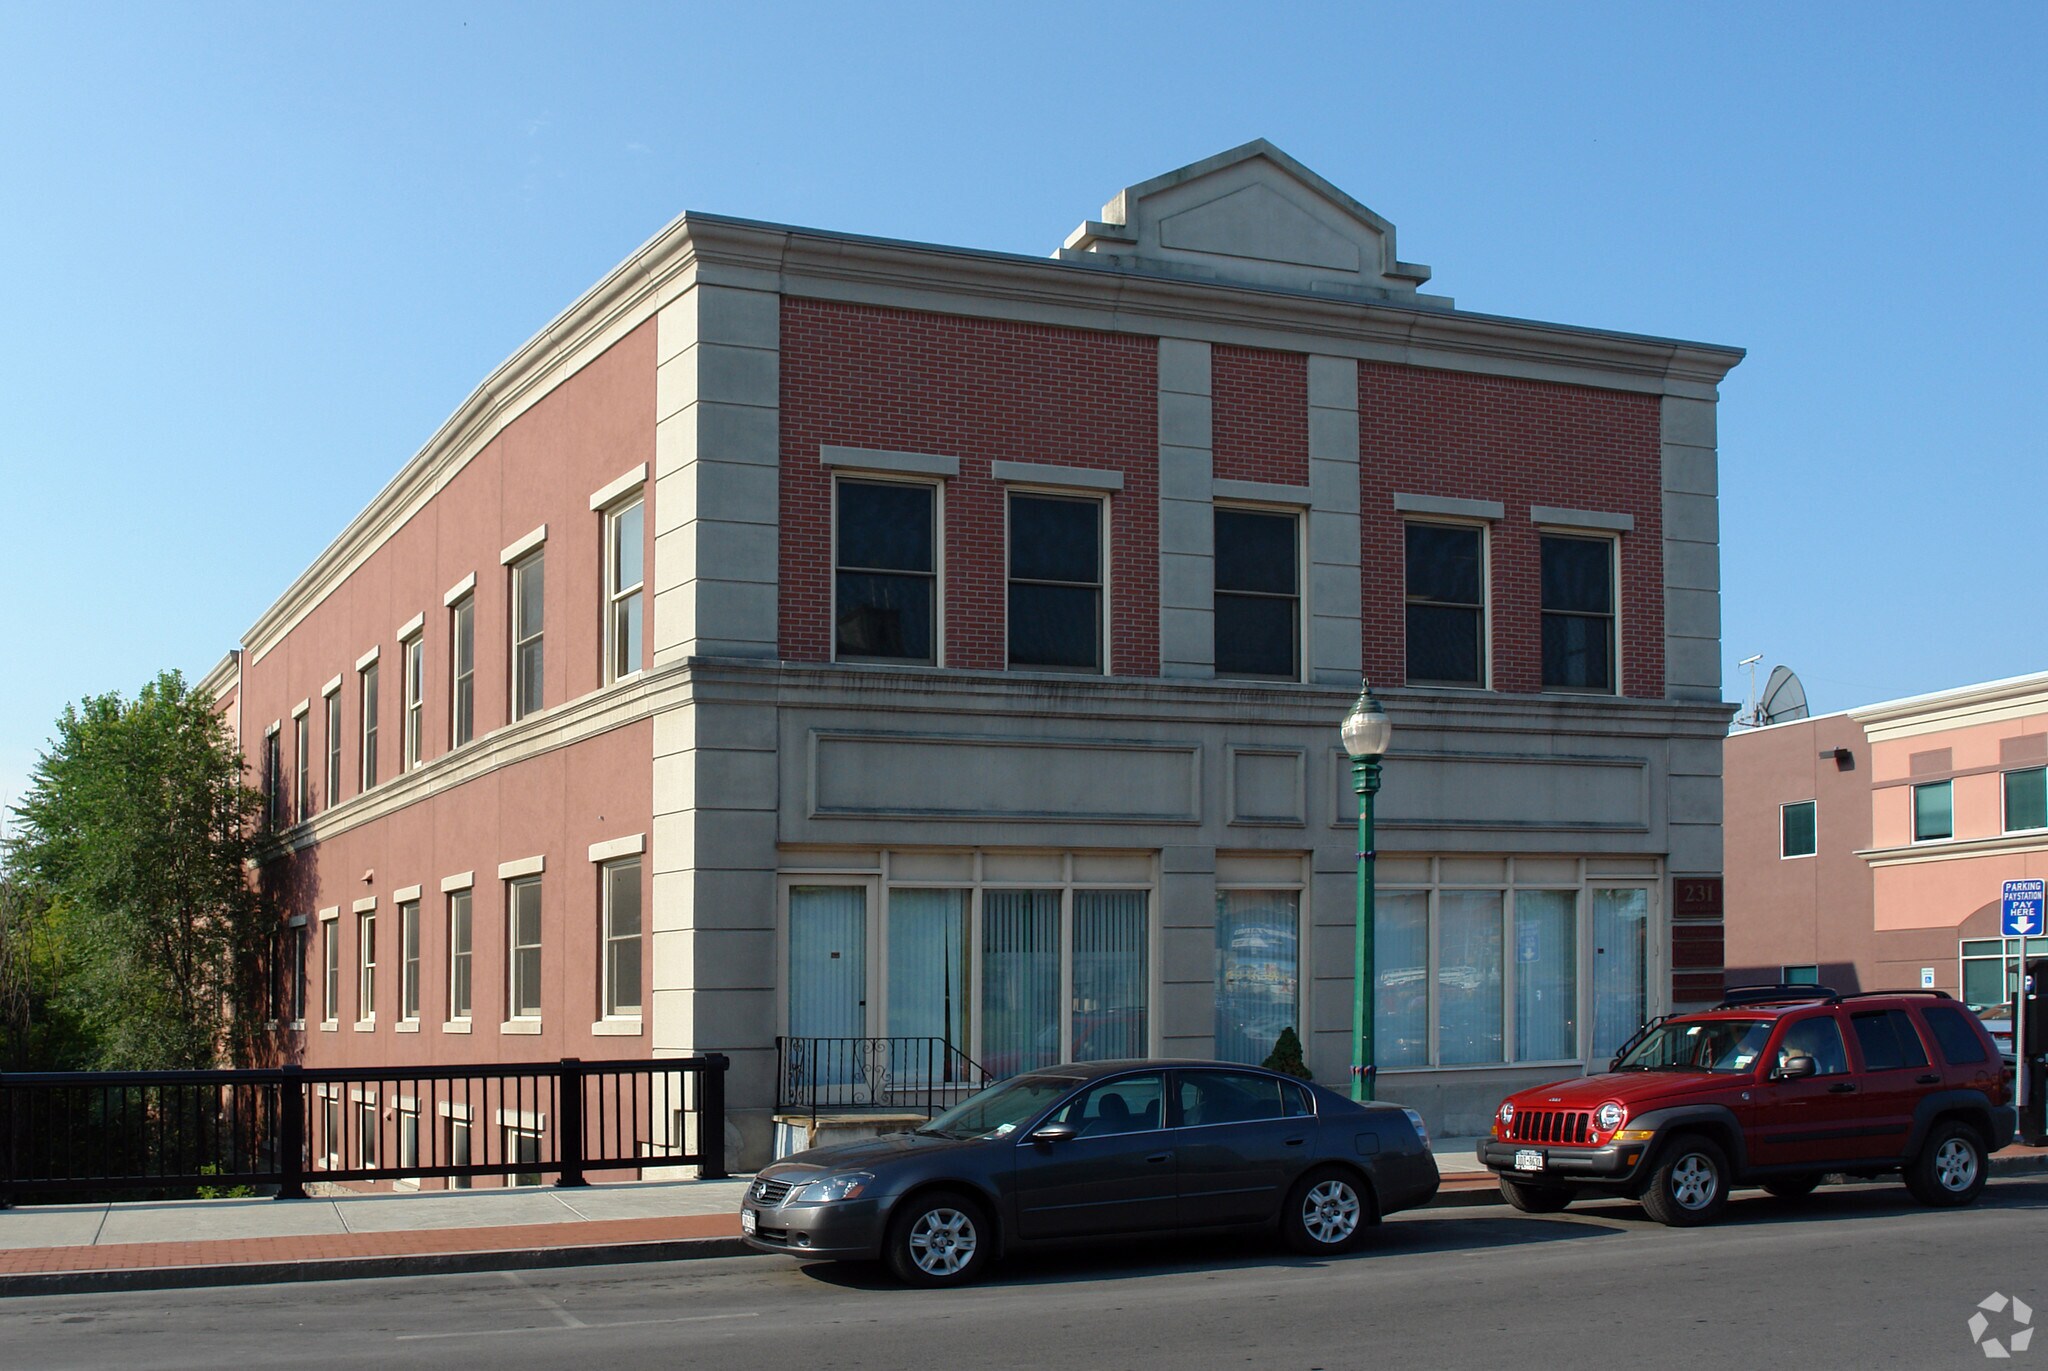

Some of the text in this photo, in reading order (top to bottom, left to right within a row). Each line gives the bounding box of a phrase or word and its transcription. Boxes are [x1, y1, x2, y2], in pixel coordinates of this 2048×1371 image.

[2006, 882, 2041, 891] PARKING
[1684, 884, 1714, 902] 231
[2010, 908, 2035, 916] HERE
